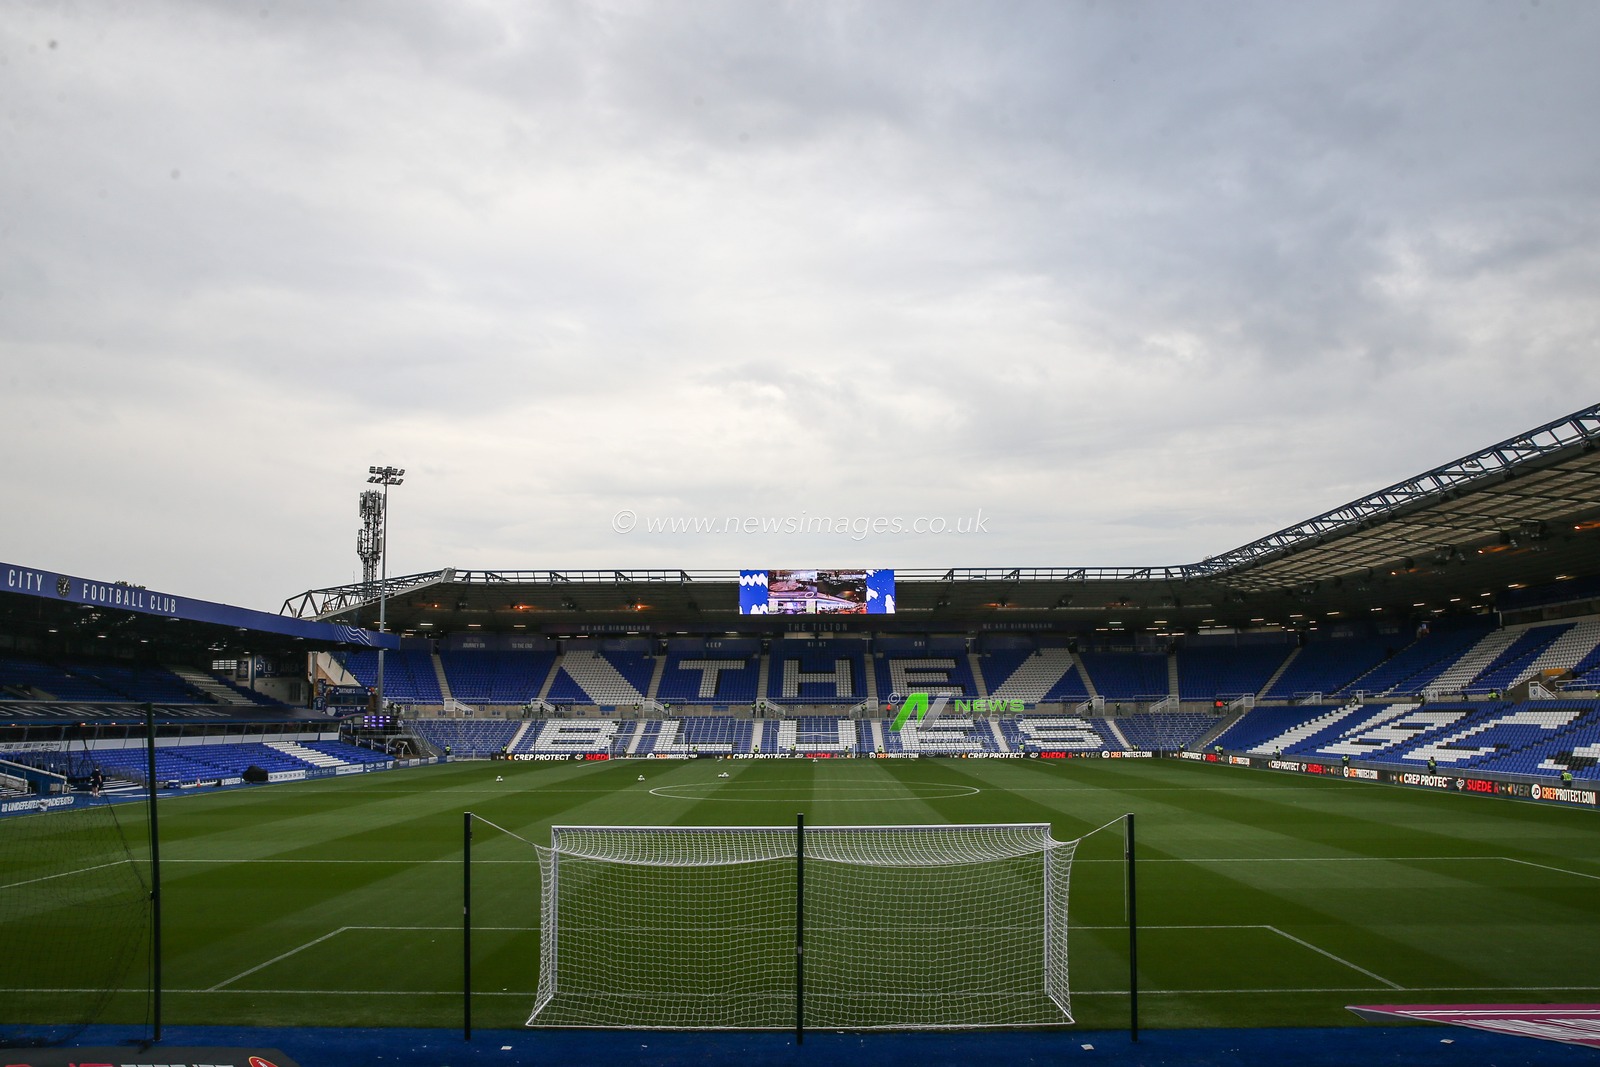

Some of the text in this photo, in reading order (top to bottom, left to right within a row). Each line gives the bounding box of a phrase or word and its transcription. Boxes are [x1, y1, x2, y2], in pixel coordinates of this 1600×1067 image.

[8, 569, 43, 592] CITY
[83, 583, 176, 613] FOOTBALL CLUB
[788, 623, 848, 631] THE TILTON
[1280, 761, 1300, 771] PROTECT
[1403, 773, 1452, 788] CREP PROTEC
[1467, 779, 1493, 793] SUEDE
[1541, 787, 1596, 805] CREPPROTECT.COM
